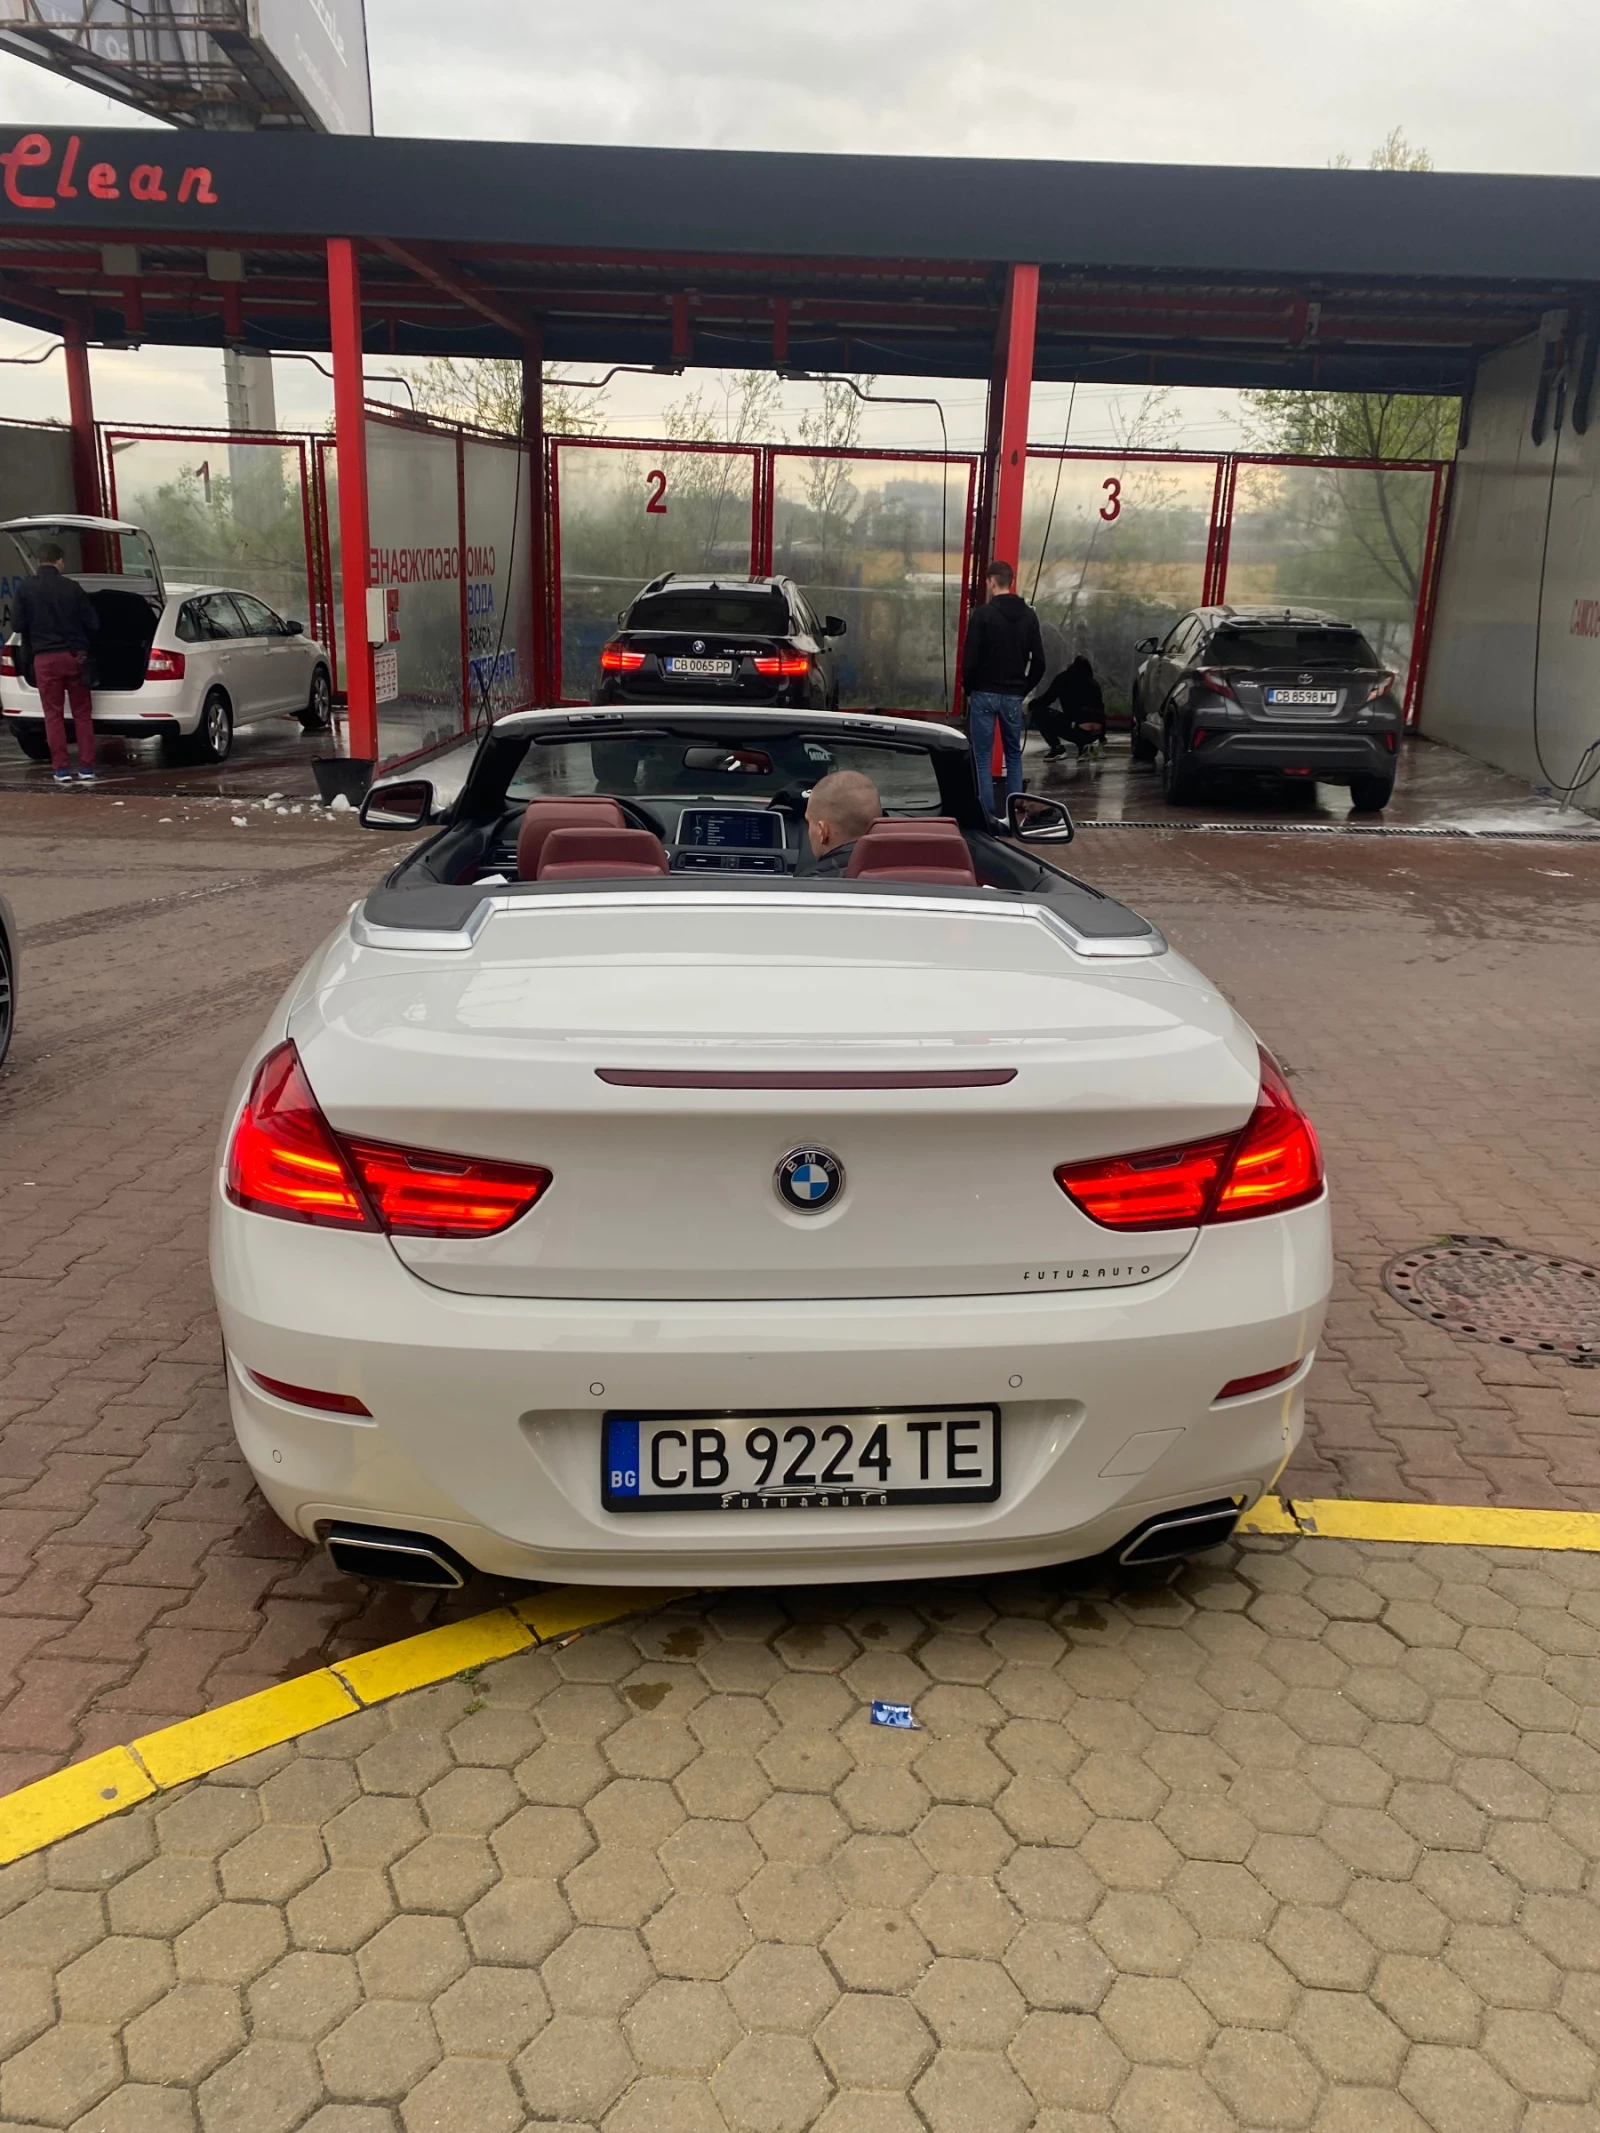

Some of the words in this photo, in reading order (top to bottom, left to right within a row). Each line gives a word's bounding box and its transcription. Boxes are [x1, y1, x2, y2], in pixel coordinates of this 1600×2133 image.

[0, 133, 218, 209] Clean
[195, 460, 212, 503] 1
[646, 469, 667, 514] 2
[1099, 477, 1121, 521] 3
[674, 659, 688, 671] CB
[690, 660, 714, 671] 0065
[716, 661, 730, 672] PP
[1275, 691, 1290, 702] CB
[1292, 691, 1318, 702] 8598
[785, 1153, 836, 1173] BMW
[1023, 1265, 1150, 1280] FUTURAUTO
[651, 1428, 730, 1488] CB
[745, 1422, 892, 1486] 9224
[906, 1420, 983, 1480] TE
[611, 1470, 636, 1488] BG
